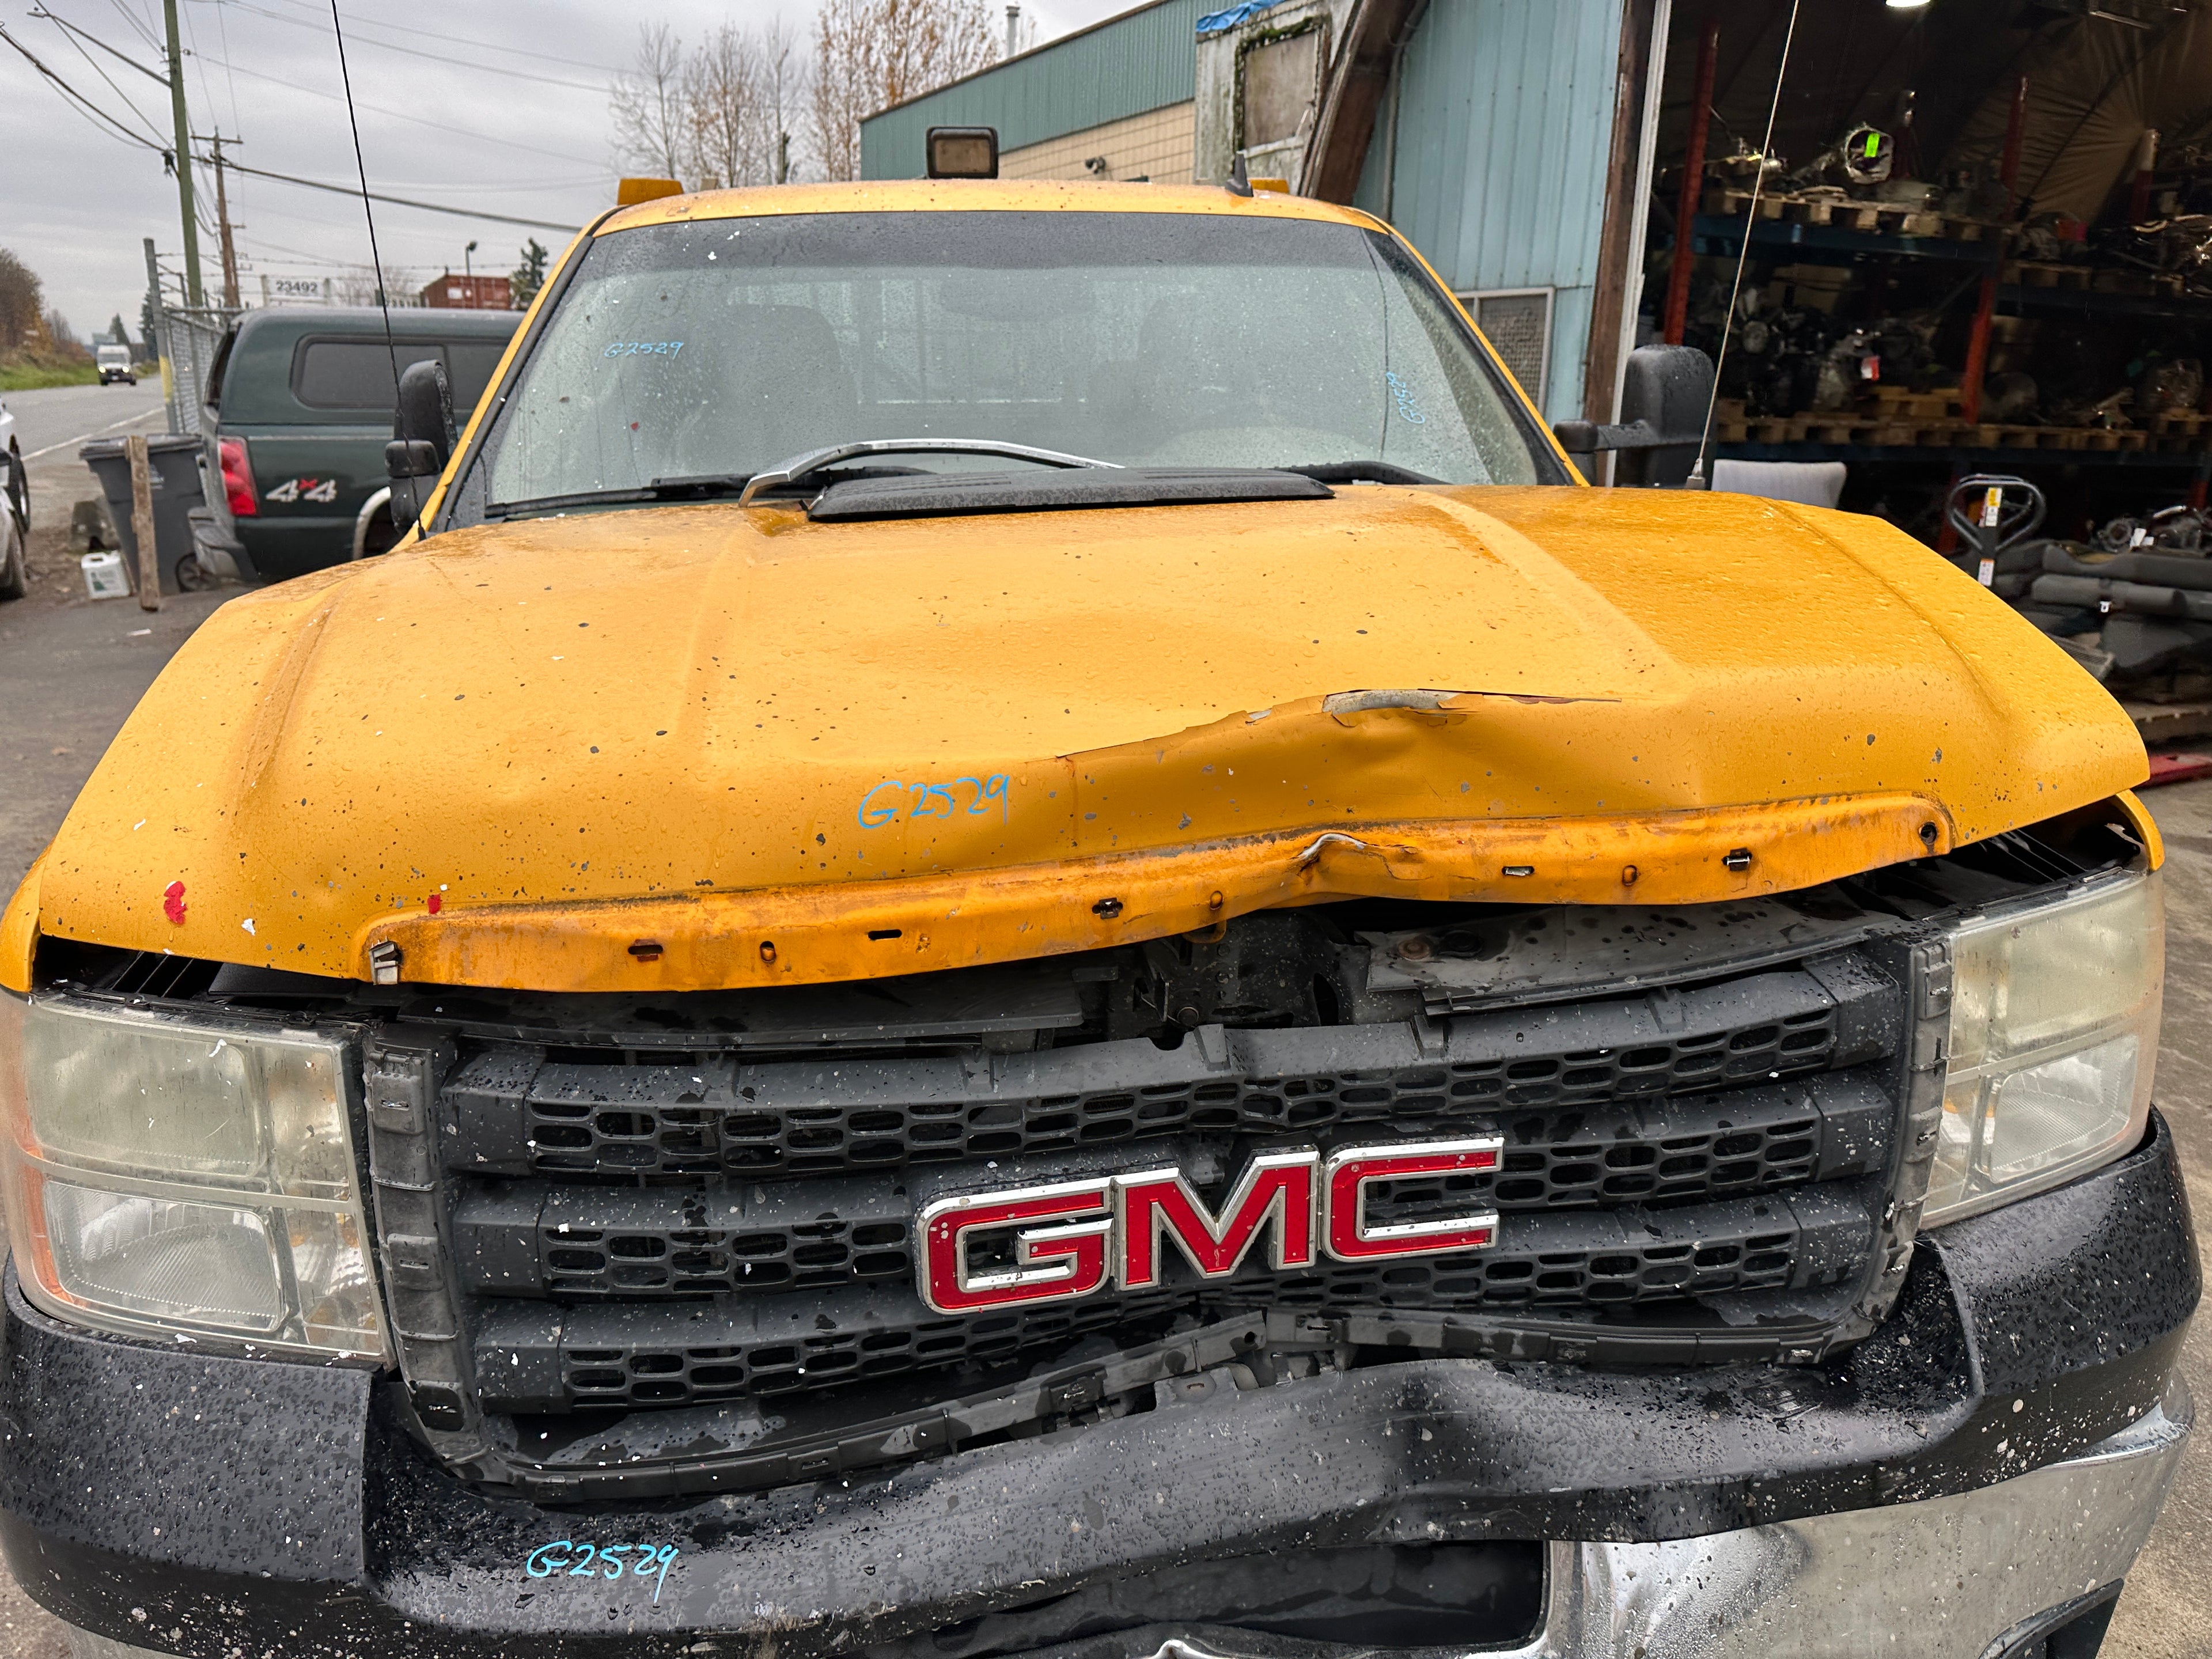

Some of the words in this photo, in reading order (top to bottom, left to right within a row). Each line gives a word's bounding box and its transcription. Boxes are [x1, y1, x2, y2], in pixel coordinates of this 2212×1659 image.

[275, 280, 317, 293] 23492
[604, 341, 684, 360] G2529
[1385, 370, 1426, 423] G2529
[857, 774, 1010, 829] G2529
[916, 1137, 1505, 1315] GMC
[525, 1540, 679, 1604] G2529
